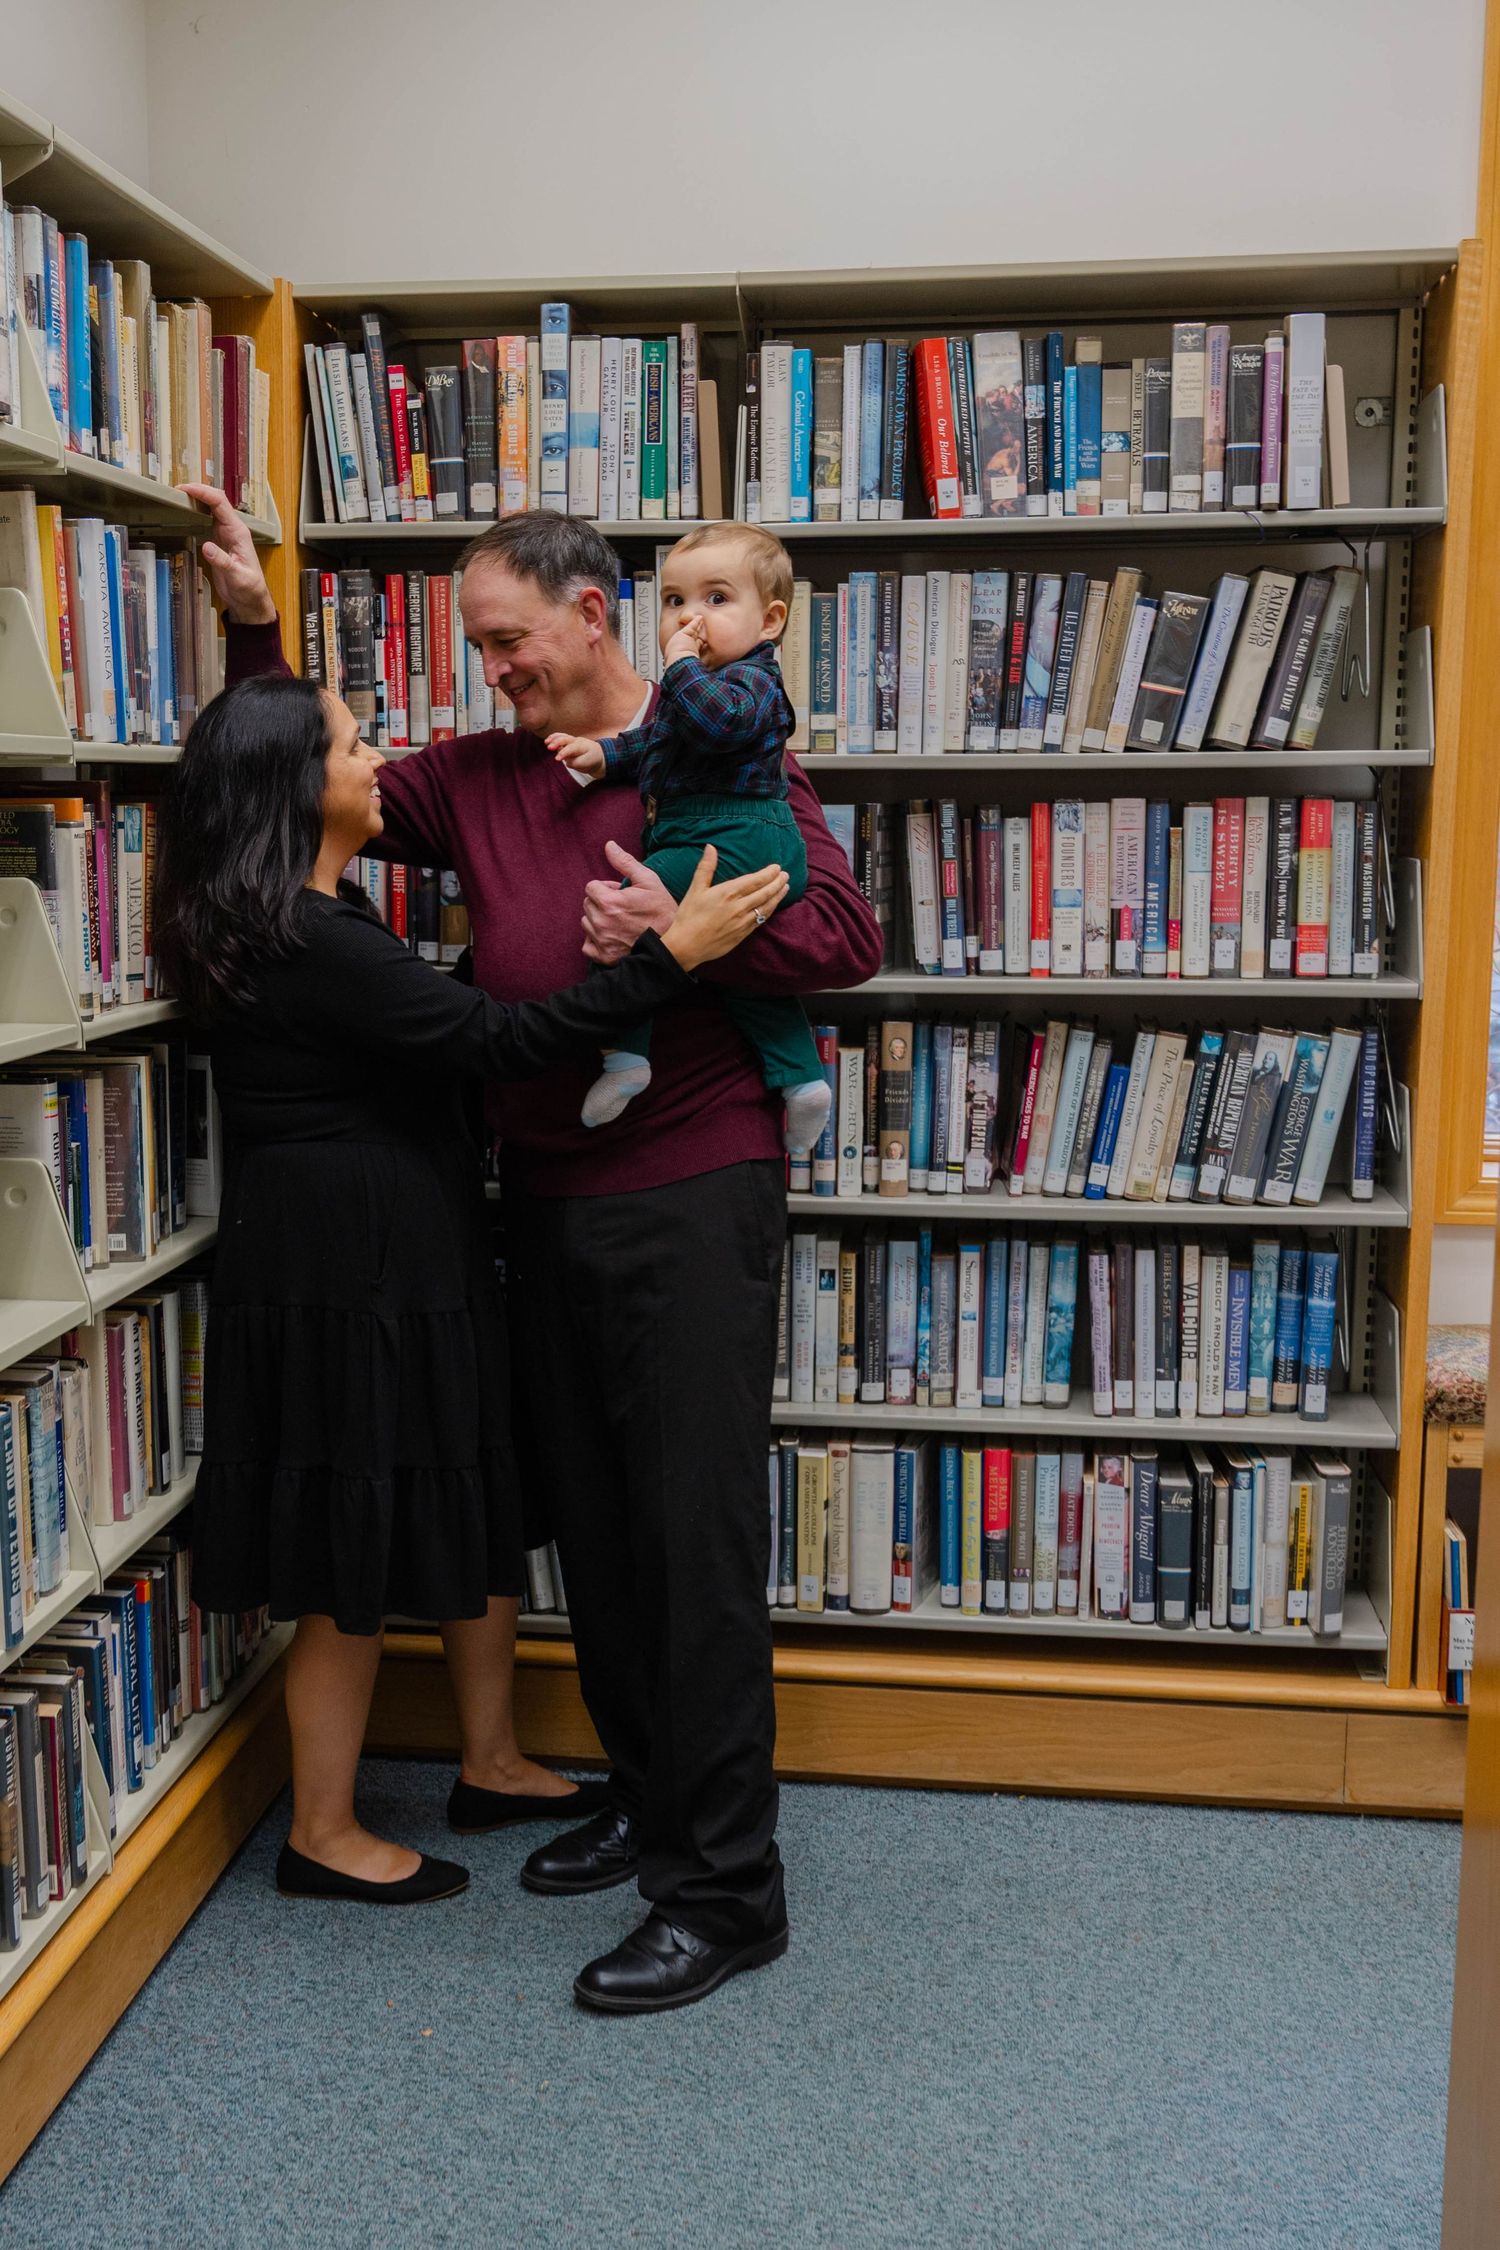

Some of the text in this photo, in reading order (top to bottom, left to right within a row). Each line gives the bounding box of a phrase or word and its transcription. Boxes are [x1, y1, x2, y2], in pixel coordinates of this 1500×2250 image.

[50, 260, 61, 339] COLUMBUS
[508, 344, 518, 368] FOUR
[767, 352, 775, 388] TAYLOR
[331, 358, 350, 449] IRISH AMERICANS
[508, 374, 518, 418] HUNDRED
[682, 374, 695, 414] SLAVERY
[935, 377, 943, 409] BROOKS
[957, 360, 968, 414] UNREDEEMED
[1053, 380, 1061, 395] THE
[399, 434, 405, 443] OF
[508, 424, 518, 454] SOULS
[750, 419, 758, 445] Empire
[795, 391, 805, 461] Colonial America
[892, 349, 906, 499] JAMESTOWN PROJECT
[938, 418, 952, 474] Our Beloved
[962, 417, 971, 455] CAPTIVE
[1132, 410, 1141, 466] BETRAYALS
[400, 446, 408, 468] BLACK
[750, 447, 758, 481] Reformed
[1027, 425, 1037, 482] AMERICA
[974, 587, 1002, 596] LEAP
[984, 575, 991, 584] A
[59, 566, 73, 665] OAK FLAT
[98, 543, 113, 680] LAKOTA AMERICA
[326, 609, 332, 617] TO
[409, 582, 422, 672] AMERICAN NIGHTMARE
[973, 605, 1002, 615] DARK
[1256, 585, 1289, 649] PATRIOTS
[306, 612, 319, 667] Walk with
[820, 603, 830, 702] BENEDICT ARNOLD
[930, 621, 939, 656] Dialogue
[1012, 621, 1024, 655] LEGENDS
[1051, 611, 1078, 715] ILL-FATED FRONTIER
[1280, 615, 1317, 713] THE GREAT DIVIDE
[1009, 667, 1020, 683] LIES
[942, 804, 955, 858] Killing England
[1215, 809, 1226, 891] IS SWEET
[1228, 815, 1240, 887] LIBERTY
[1247, 817, 1257, 875] REVOLUTION
[393, 864, 404, 893] BLUFF
[1061, 837, 1075, 886] FOUNDERS
[1116, 836, 1125, 895] REVOLUTIONS
[1127, 835, 1138, 895] AMERICAN
[1305, 853, 1315, 919] REVOLUTION
[1362, 813, 1373, 919] FRANKLIN WASHINGTON
[129, 878, 143, 955] MEXICO
[1146, 882, 1158, 942] AMERICA
[1277, 880, 1288, 917] FOUNDING
[1124, 1072, 1140, 1127] REVOLUTION
[1229, 1050, 1253, 1095] AMERICAN
[1283, 1058, 1310, 1136] WASHINGTON'S
[1362, 1034, 1377, 1118] BAND OF GIANTS
[1021, 1067, 1037, 1139] AMERICA GOES TO WAR
[1059, 1056, 1085, 1168] DEFIANCE OF THE PATRIOTS
[1145, 1048, 1179, 1156] The Price of Loyalty
[1188, 1061, 1216, 1155] TRIUMVIRATE
[1218, 1098, 1243, 1150] REPUBLICS
[1293, 1096, 1310, 1137] GEORGE
[1274, 1138, 1300, 1182] WAR
[842, 1267, 853, 1295] RIDE
[964, 1261, 976, 1303] Saratoga
[1182, 1283, 1197, 1359] VALCOUR
[1228, 1297, 1245, 1390] INVISIBLE MEN
[132, 1322, 144, 1438] MYTH AMERICA
[3, 1437, 16, 1491] LAND
[899, 1454, 908, 1503] WASHINGTON'S
[946, 1449, 954, 1500] GLENN BECK
[1039, 1467, 1048, 1516] PHILBRICK
[8, 1500, 17, 1519] OF
[832, 1461, 845, 1557] Our Sacred Honor
[989, 1466, 998, 1521] MELTZER
[999, 1477, 1008, 1510] BRAD
[1049, 1465, 1058, 1519] NATHANIEL
[1139, 1470, 1153, 1561] Dear Abigail
[1238, 1547, 1246, 1582] LEGEND
[1325, 1525, 1337, 1590] MONTICELLO
[126, 1598, 138, 1692] CULTURAL
